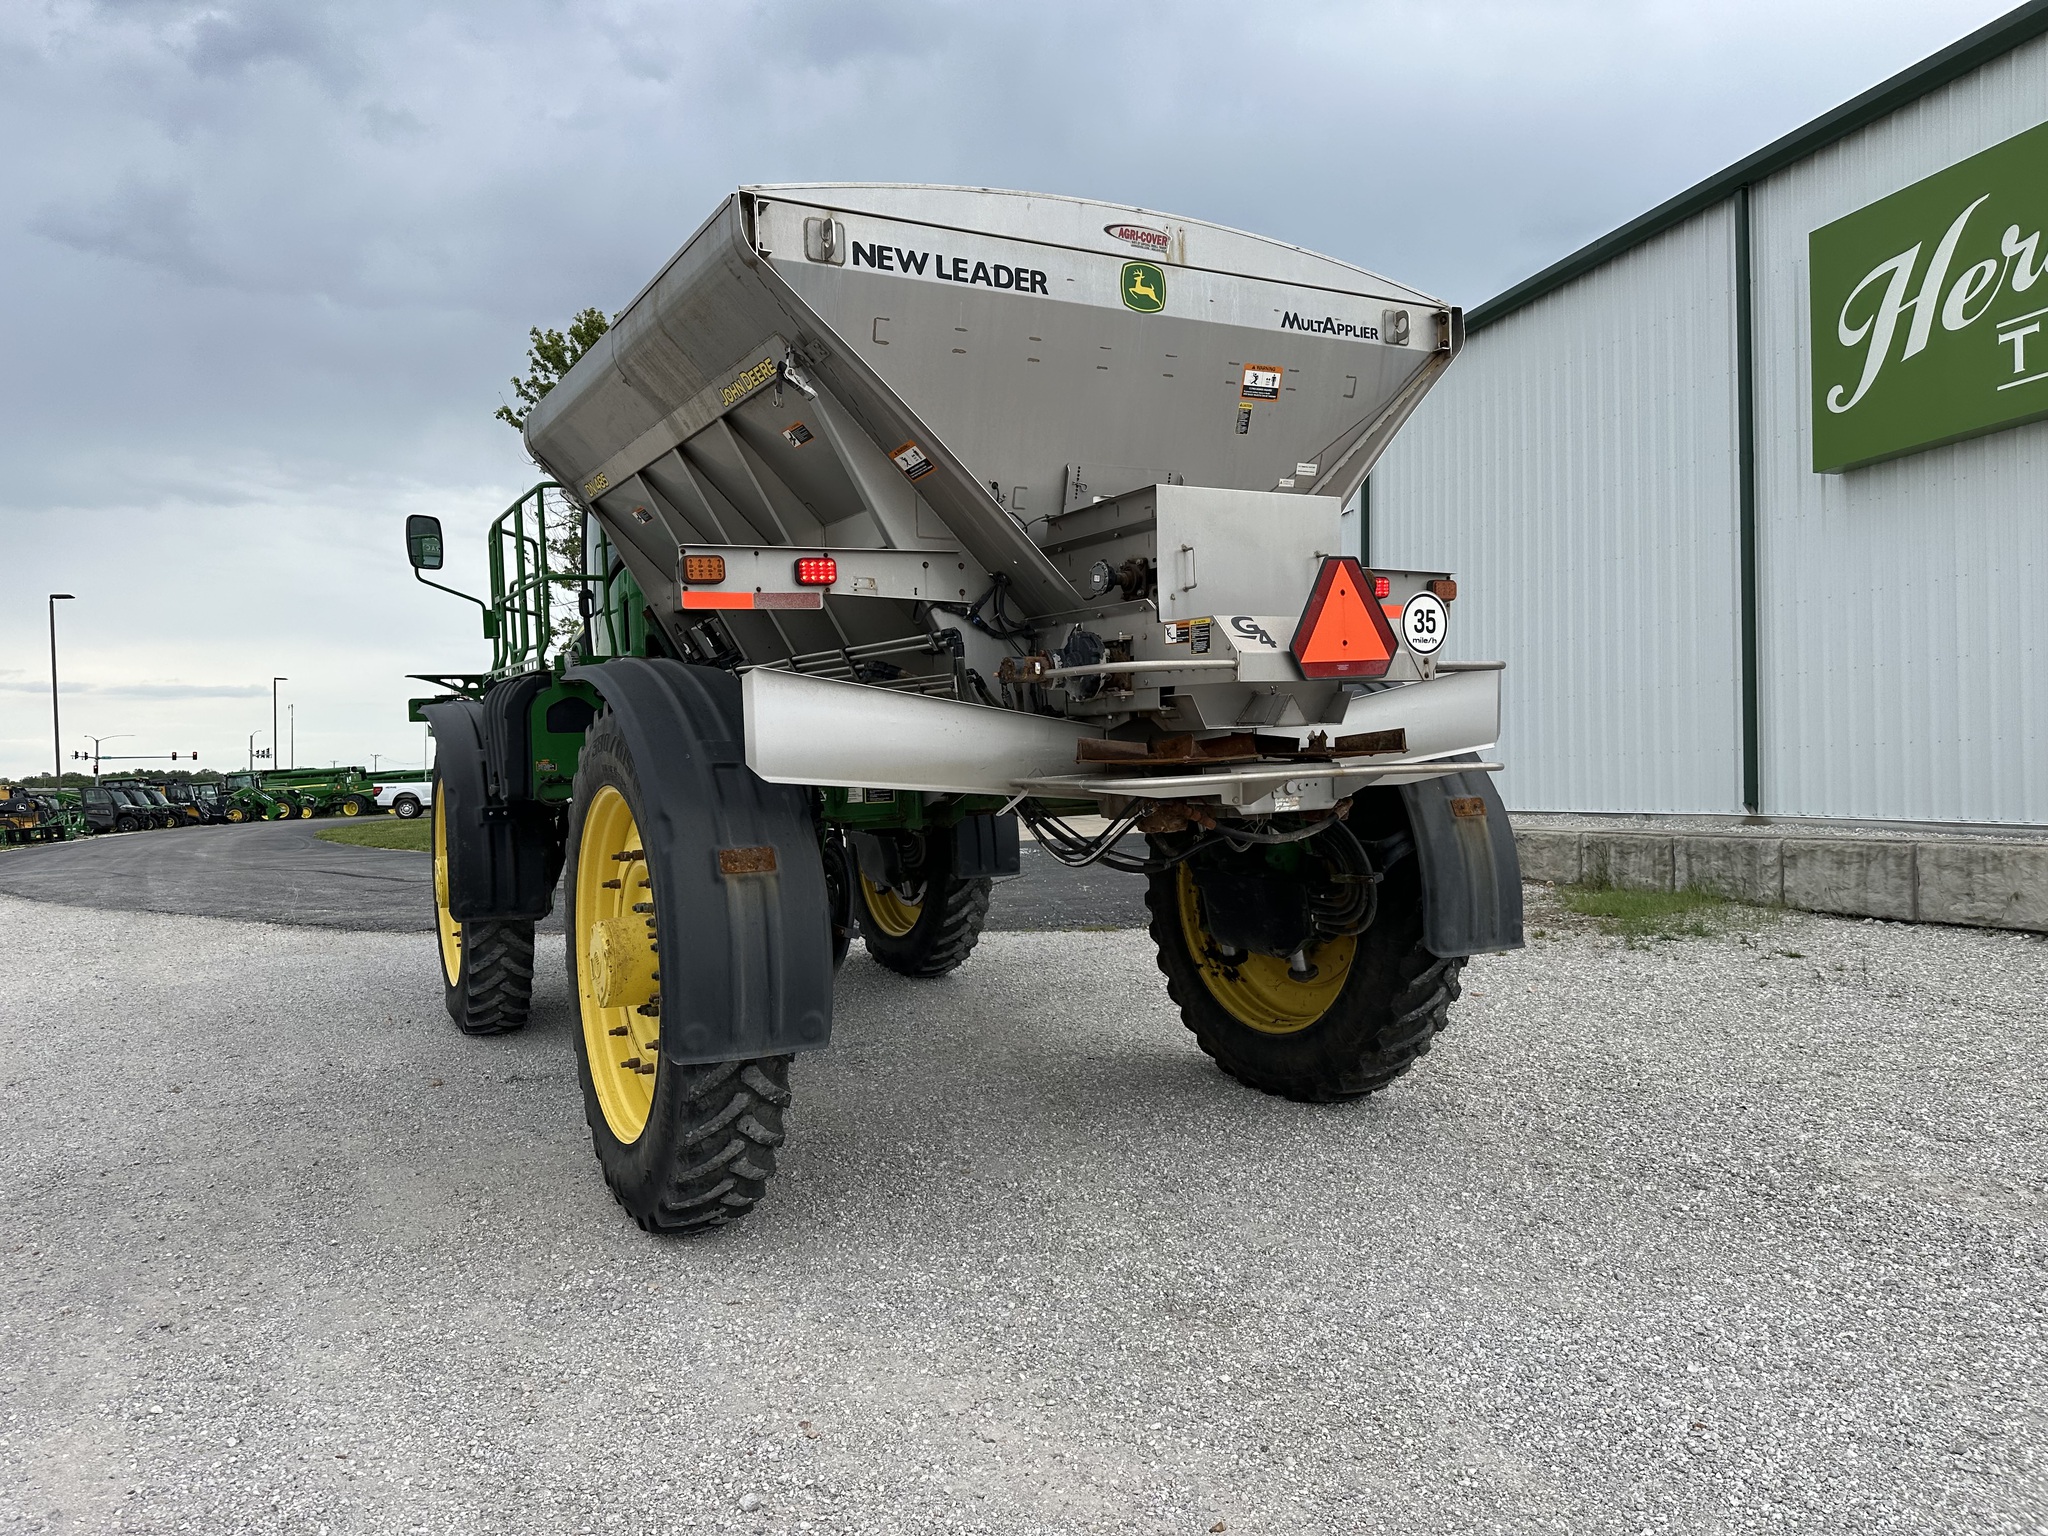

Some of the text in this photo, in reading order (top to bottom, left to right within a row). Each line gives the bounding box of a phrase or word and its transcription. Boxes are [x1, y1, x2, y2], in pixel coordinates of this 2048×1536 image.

[1118, 227, 1168, 247] AGRI-COVER
[852, 241, 1049, 295] NEW LEADER
[1827, 193, 2048, 413] Her
[718, 356, 777, 407] JOHN DEERE
[1231, 616, 1277, 648] G4
[1413, 609, 1436, 634] 35
